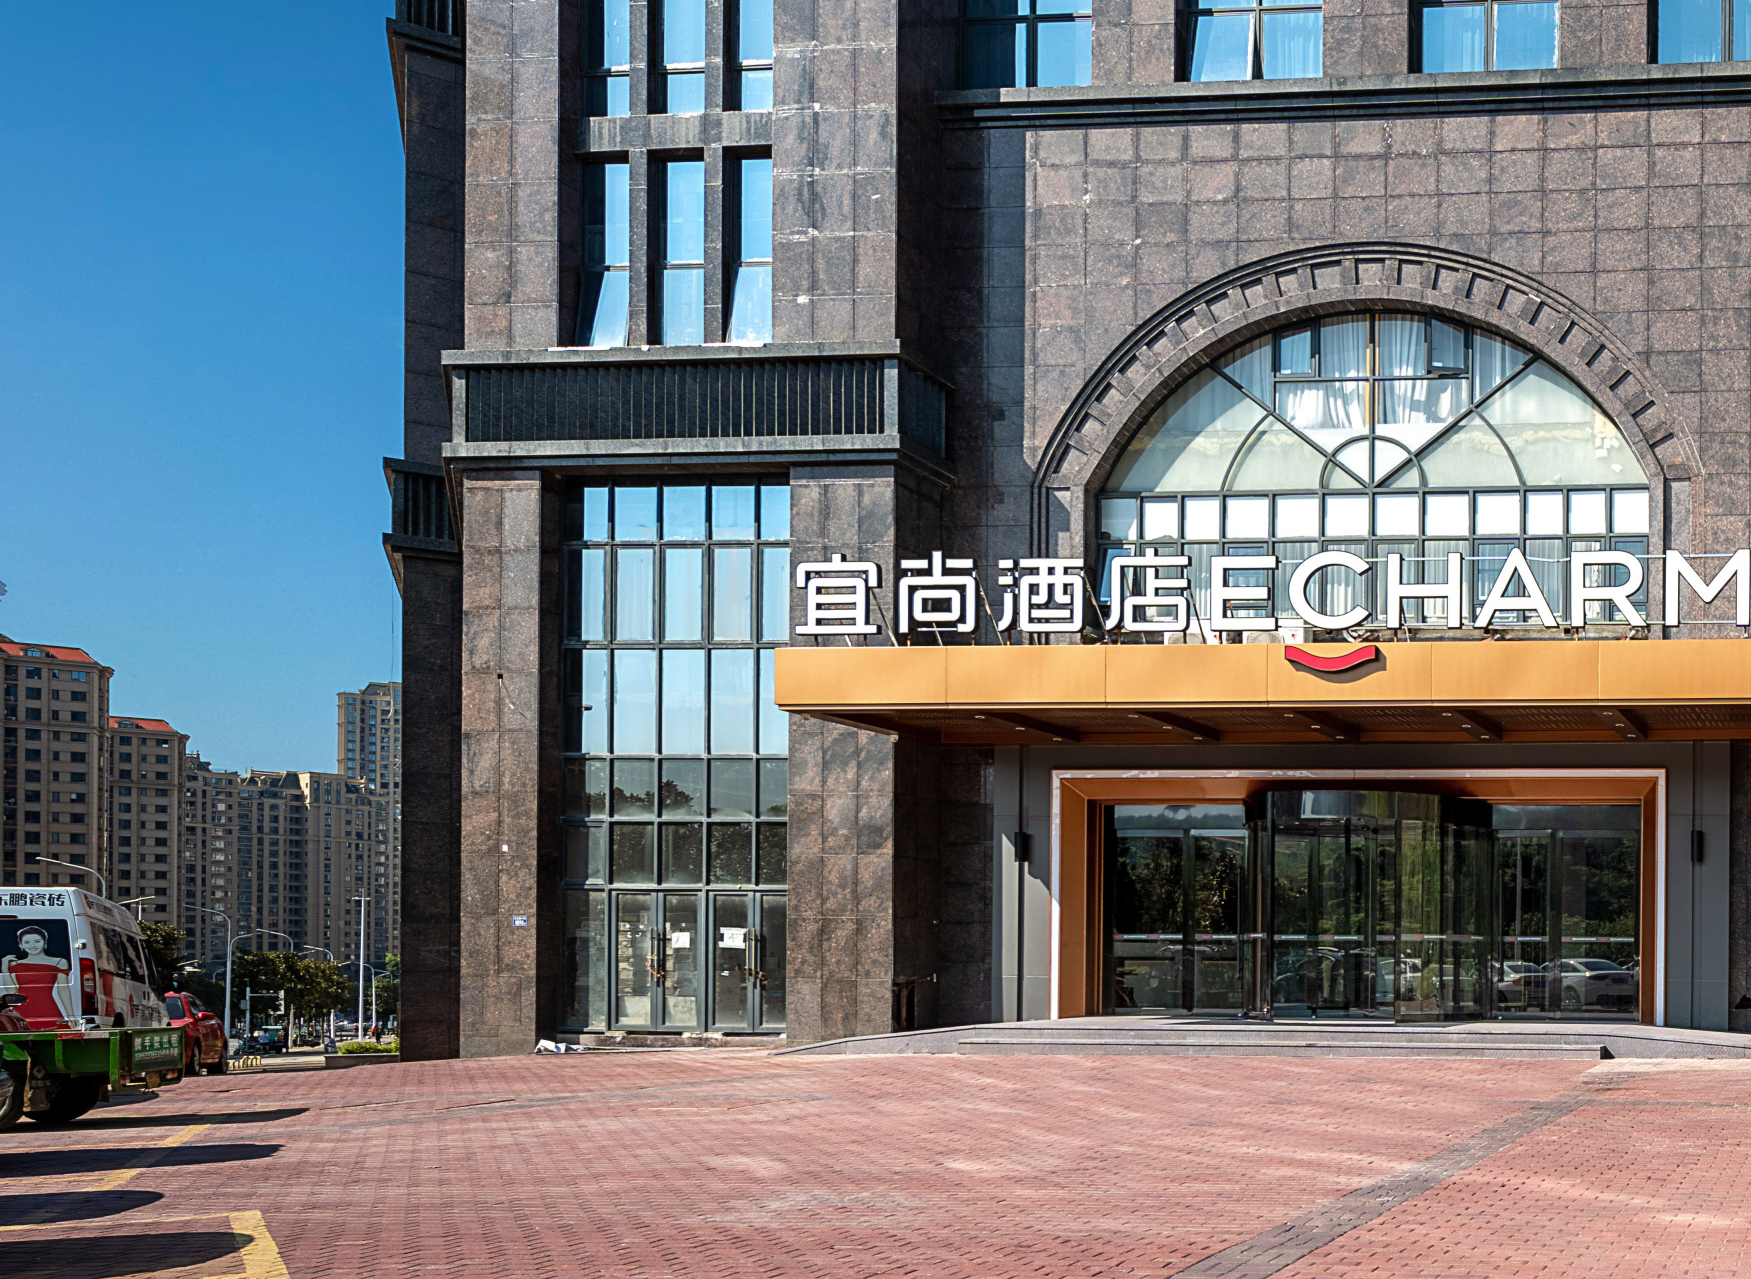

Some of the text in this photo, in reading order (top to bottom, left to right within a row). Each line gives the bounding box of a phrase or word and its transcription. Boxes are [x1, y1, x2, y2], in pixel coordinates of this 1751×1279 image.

[795, 546, 1751, 635] 宜尚酒店 ECHARM
